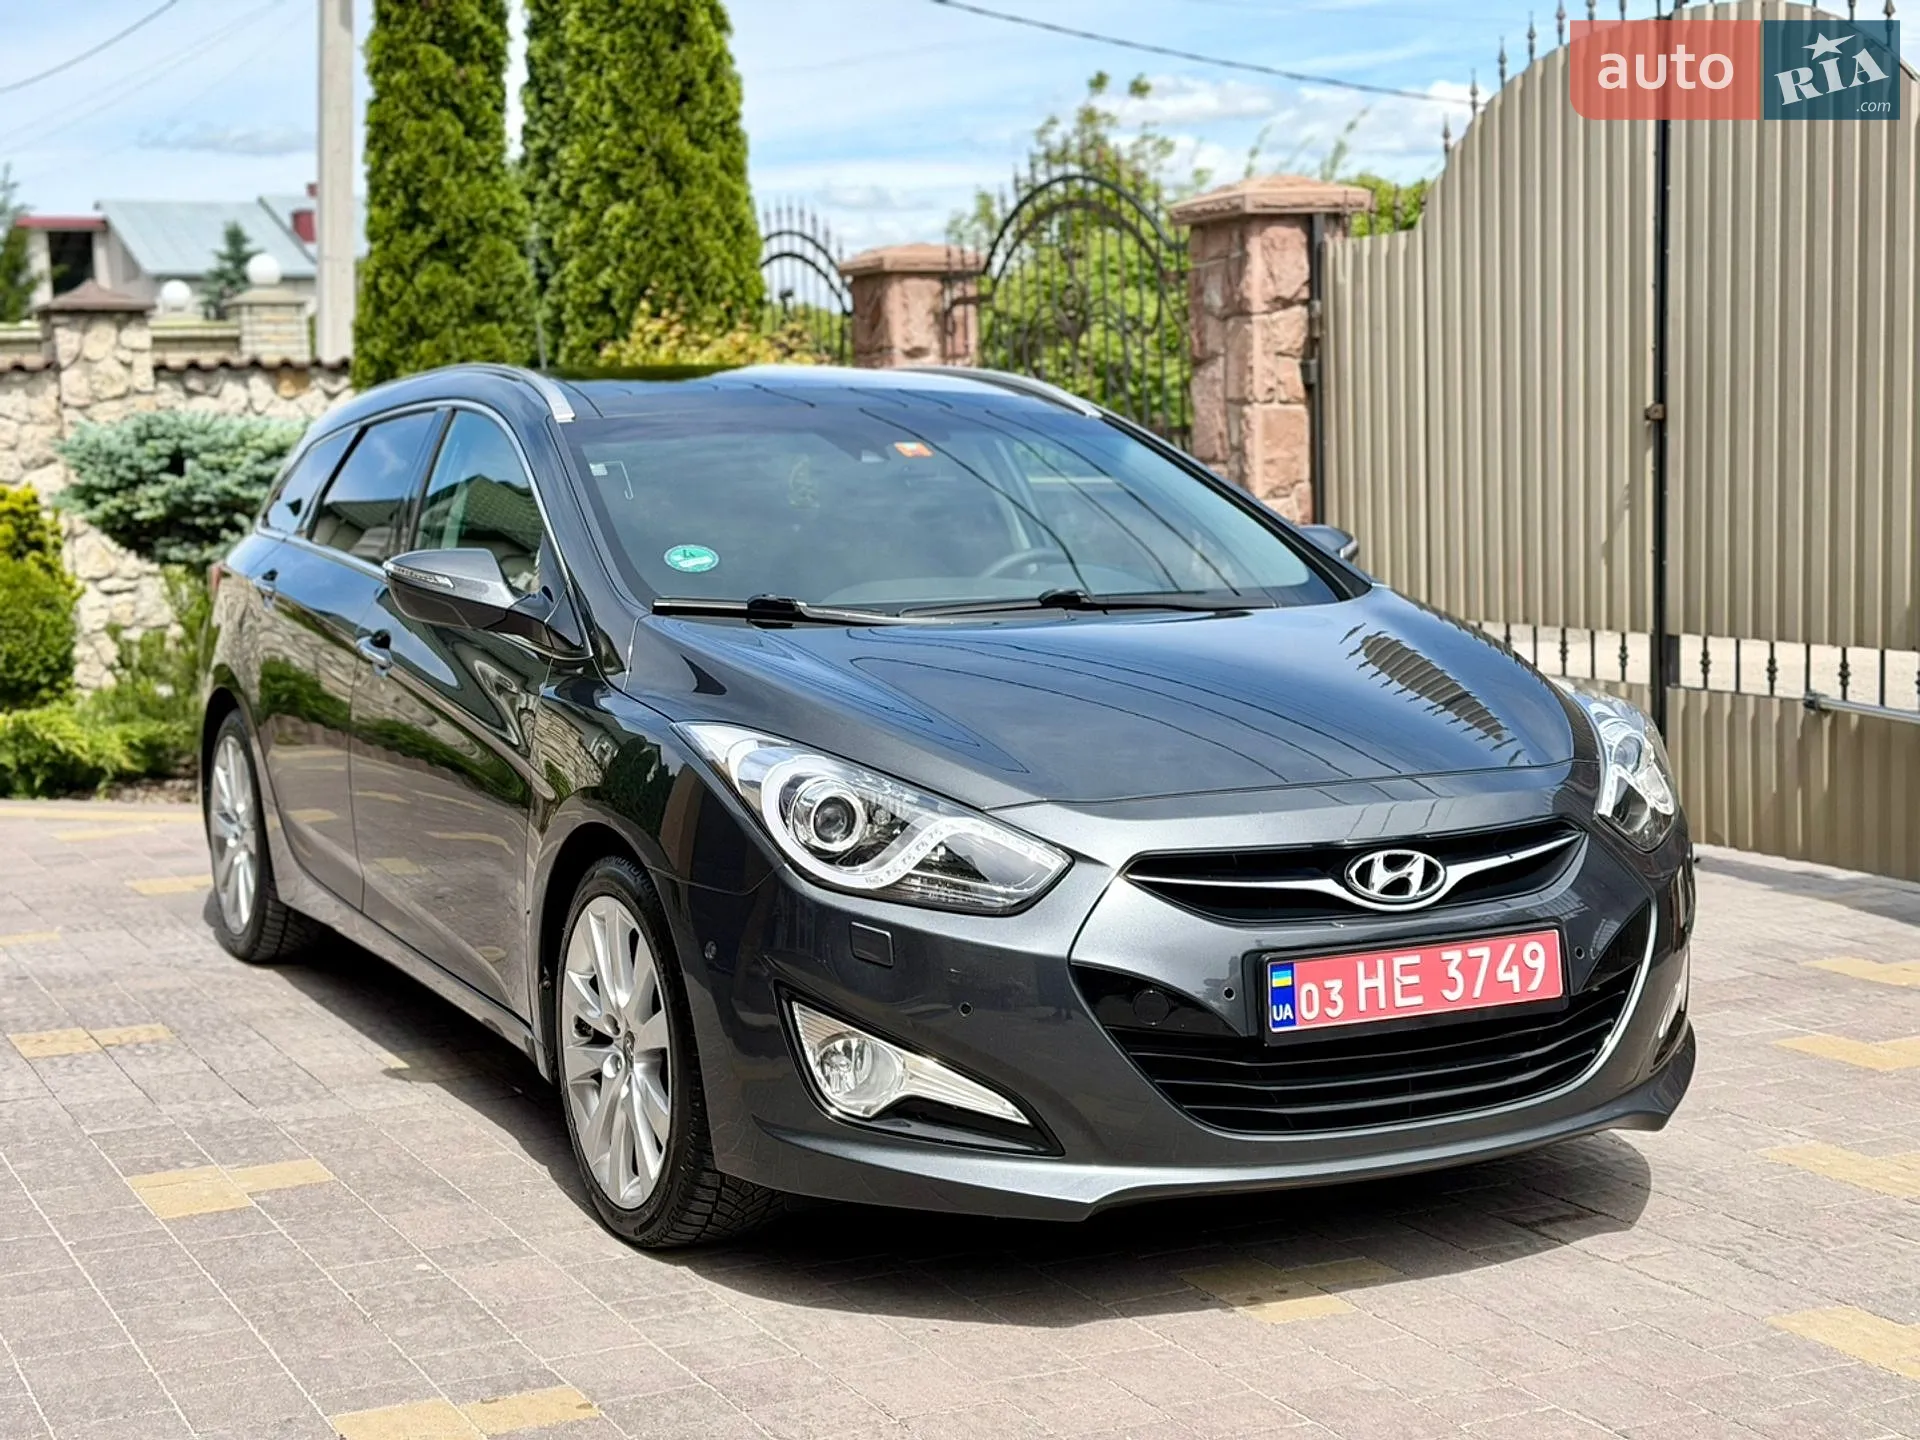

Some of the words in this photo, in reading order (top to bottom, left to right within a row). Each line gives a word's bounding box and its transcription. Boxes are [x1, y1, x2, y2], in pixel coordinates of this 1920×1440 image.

[1299, 979, 1344, 1021] 03
[1357, 955, 1424, 1011] HE
[1440, 941, 1546, 1002] 3749
[1273, 1003, 1293, 1021] UA
